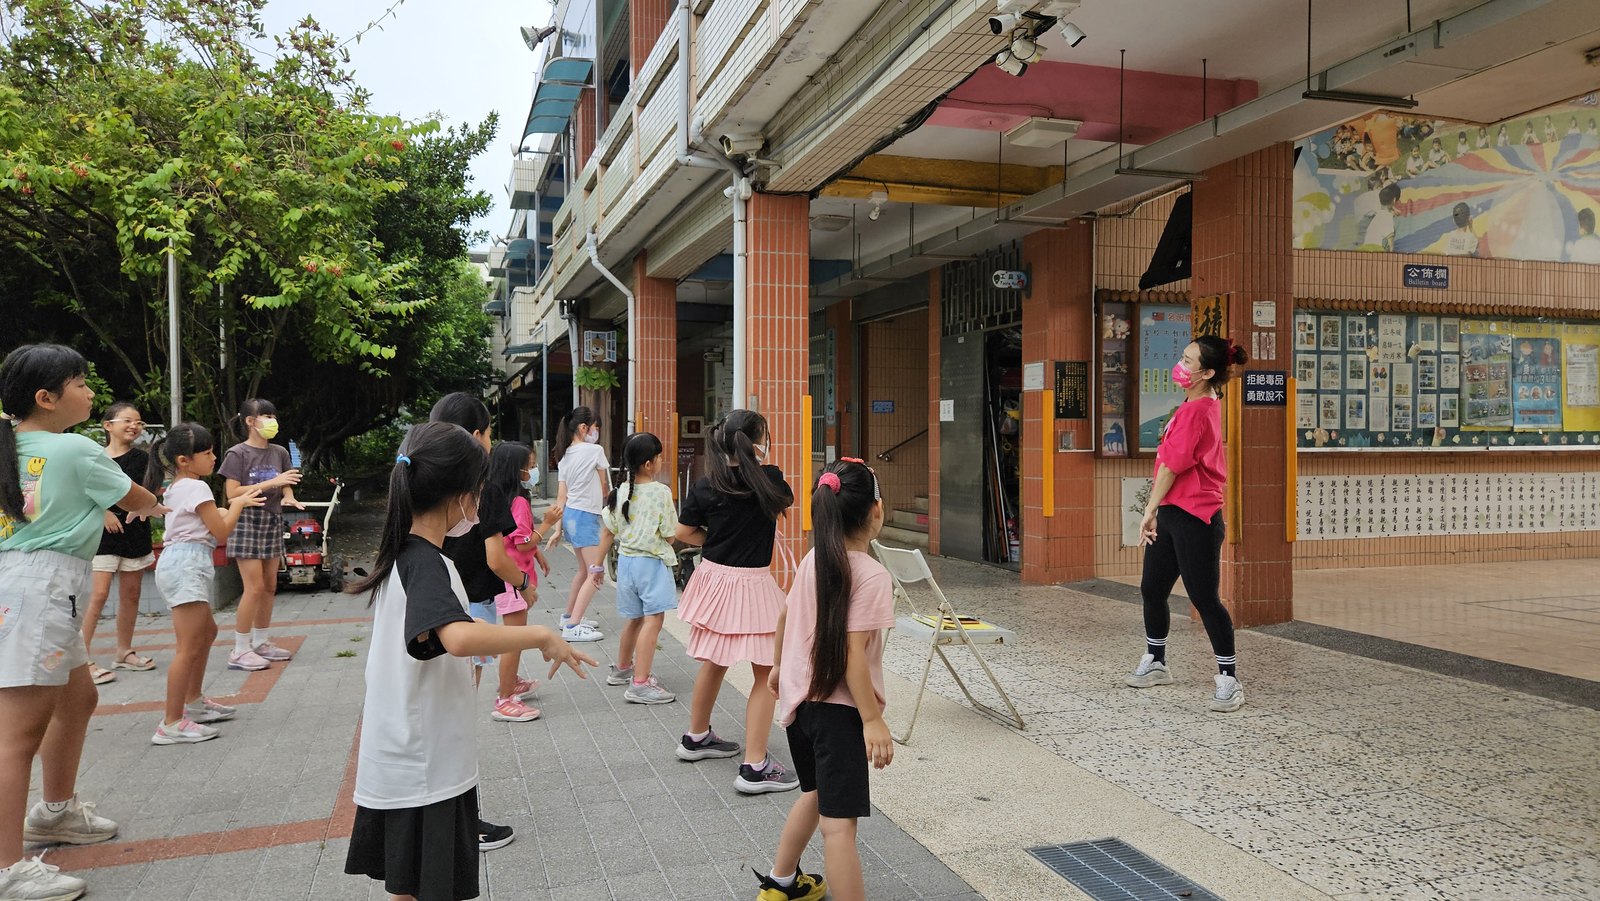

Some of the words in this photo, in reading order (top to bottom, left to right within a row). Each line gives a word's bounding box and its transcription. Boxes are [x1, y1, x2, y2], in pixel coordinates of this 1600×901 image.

[1407, 267, 1447, 279] 公佈欄
[1247, 375, 1284, 385] 拒絕毒品
[1247, 390, 1284, 402] 勇敢說不
